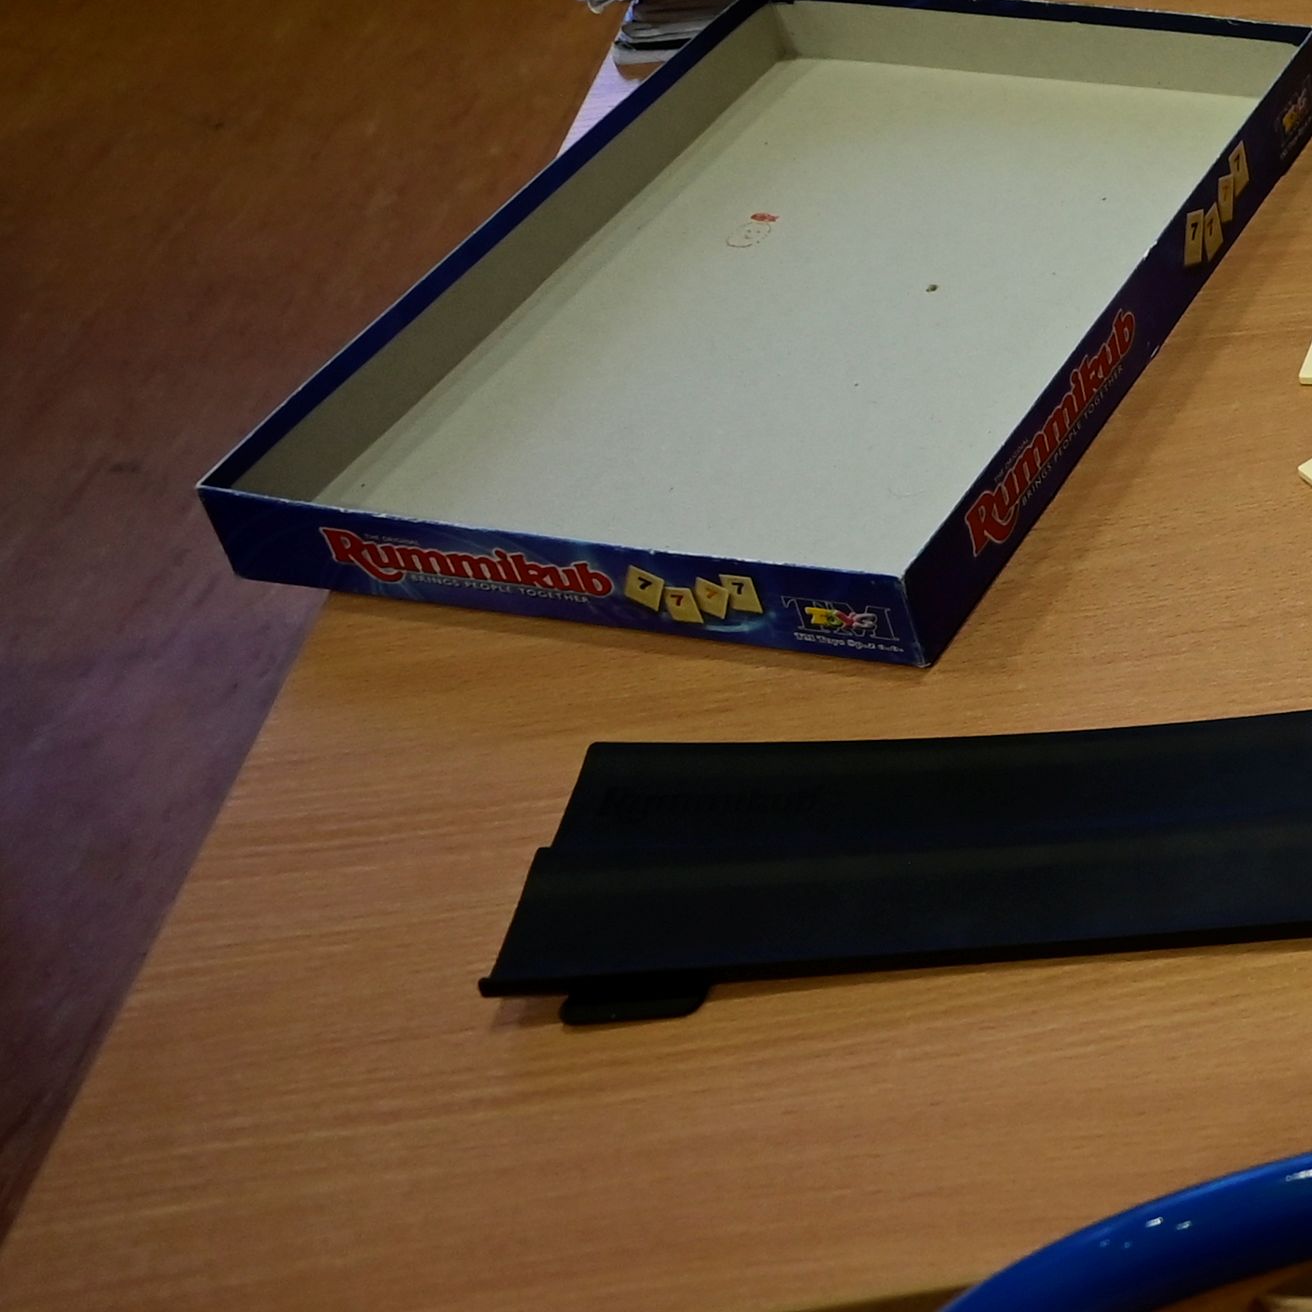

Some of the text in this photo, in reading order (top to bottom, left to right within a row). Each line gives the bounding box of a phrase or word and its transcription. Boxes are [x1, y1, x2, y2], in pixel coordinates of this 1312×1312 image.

[965, 308, 1135, 557] Rummikub
[1021, 365, 1125, 507] BRINGS PEOPLE TOGETHER
[319, 527, 614, 598] Rummikub
[410, 574, 590, 603] BRINGS PEOPLE TOGETHER
[638, 577, 652, 590] 7
[670, 594, 683, 606] 7
[732, 582, 744, 595] 7
